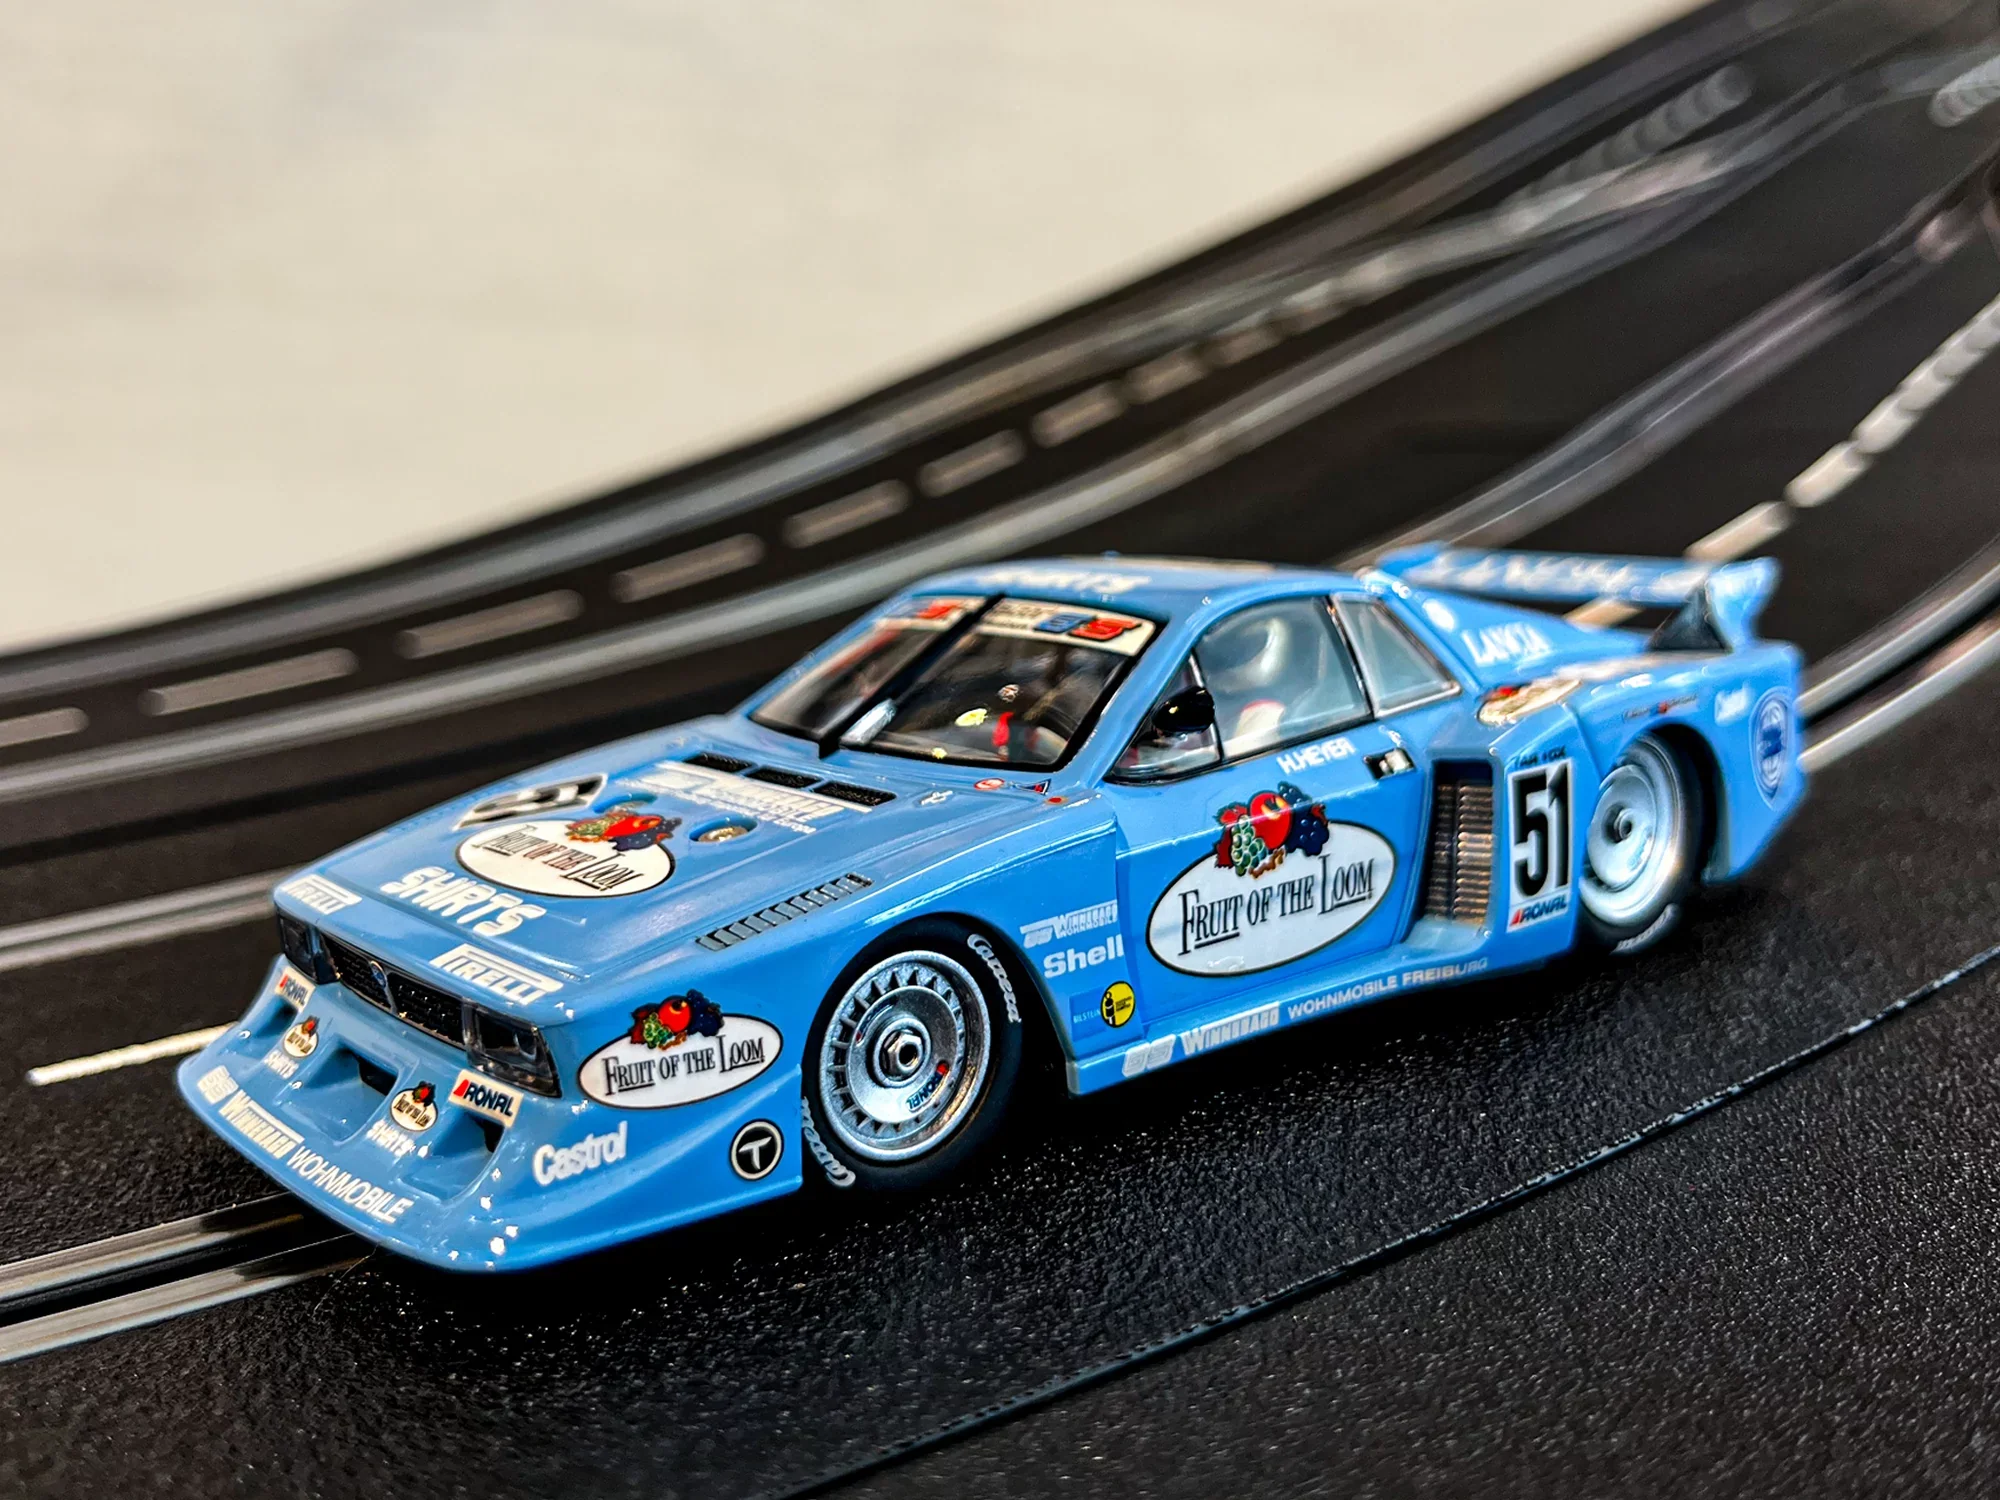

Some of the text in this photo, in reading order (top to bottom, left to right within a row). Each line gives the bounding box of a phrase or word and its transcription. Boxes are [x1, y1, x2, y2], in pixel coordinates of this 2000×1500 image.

[472, 824, 644, 891] FRUIT OF THE LOOM
[1512, 761, 1569, 897] 51
[283, 873, 362, 915] PIRELLI
[380, 866, 547, 937] SHIRTS
[1178, 853, 1375, 955] FRUIT OF THE LOOM
[1520, 896, 1568, 922] RONAL
[429, 943, 564, 1004] PIRELLI
[1043, 933, 1125, 978] Shell
[1180, 957, 1489, 1056] WINNEBAGO WOHNMOBILE FREIBURG
[602, 1034, 766, 1096] FRUIT OF THE LOOM
[463, 1082, 515, 1118] RONAL
[286, 1145, 414, 1224] WOHNMOBILE
[533, 1121, 629, 1187] Castrol
